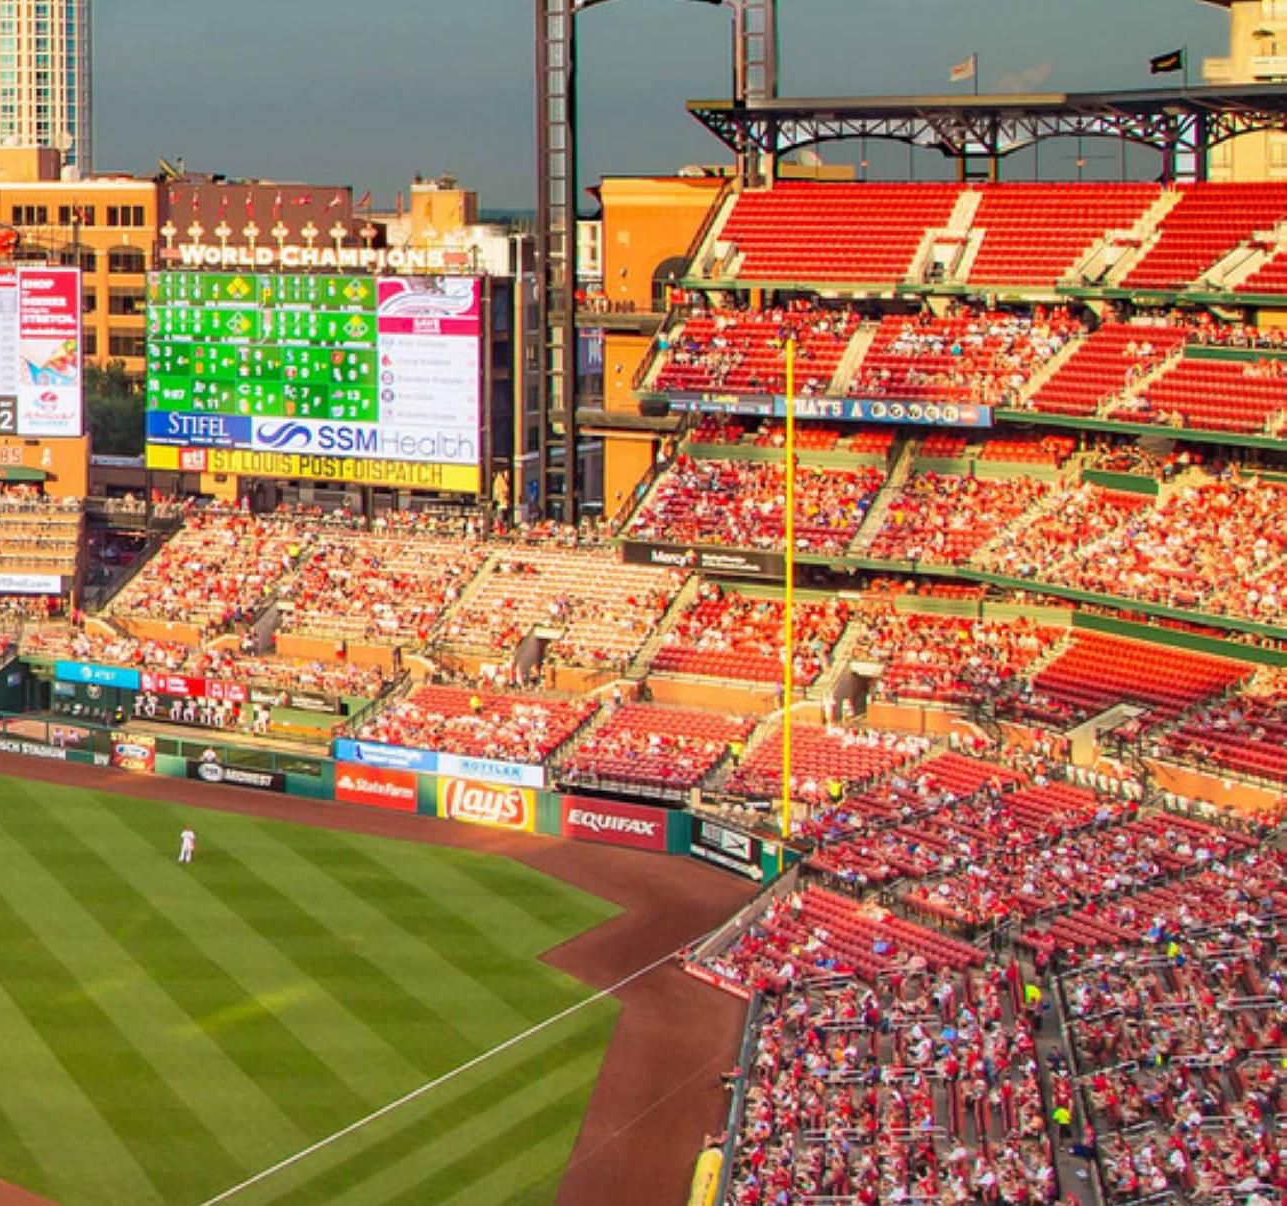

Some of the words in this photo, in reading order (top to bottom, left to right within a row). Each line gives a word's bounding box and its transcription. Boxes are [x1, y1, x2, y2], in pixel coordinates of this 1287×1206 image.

[179, 243, 274, 266] WORLD
[279, 245, 445, 269] CHAMPIONS
[784, 395, 843, 418] HAT'S
[168, 413, 230, 437] STIFEL
[317, 425, 378, 453] SSM
[380, 430, 475, 459] Health
[240, 452, 292, 473] LOUIS
[298, 455, 443, 485] POST-DISPATCH
[22, 742, 67, 760] STADIUM
[453, 781, 518, 821] Lay's
[567, 808, 655, 837] EQUIFAX
